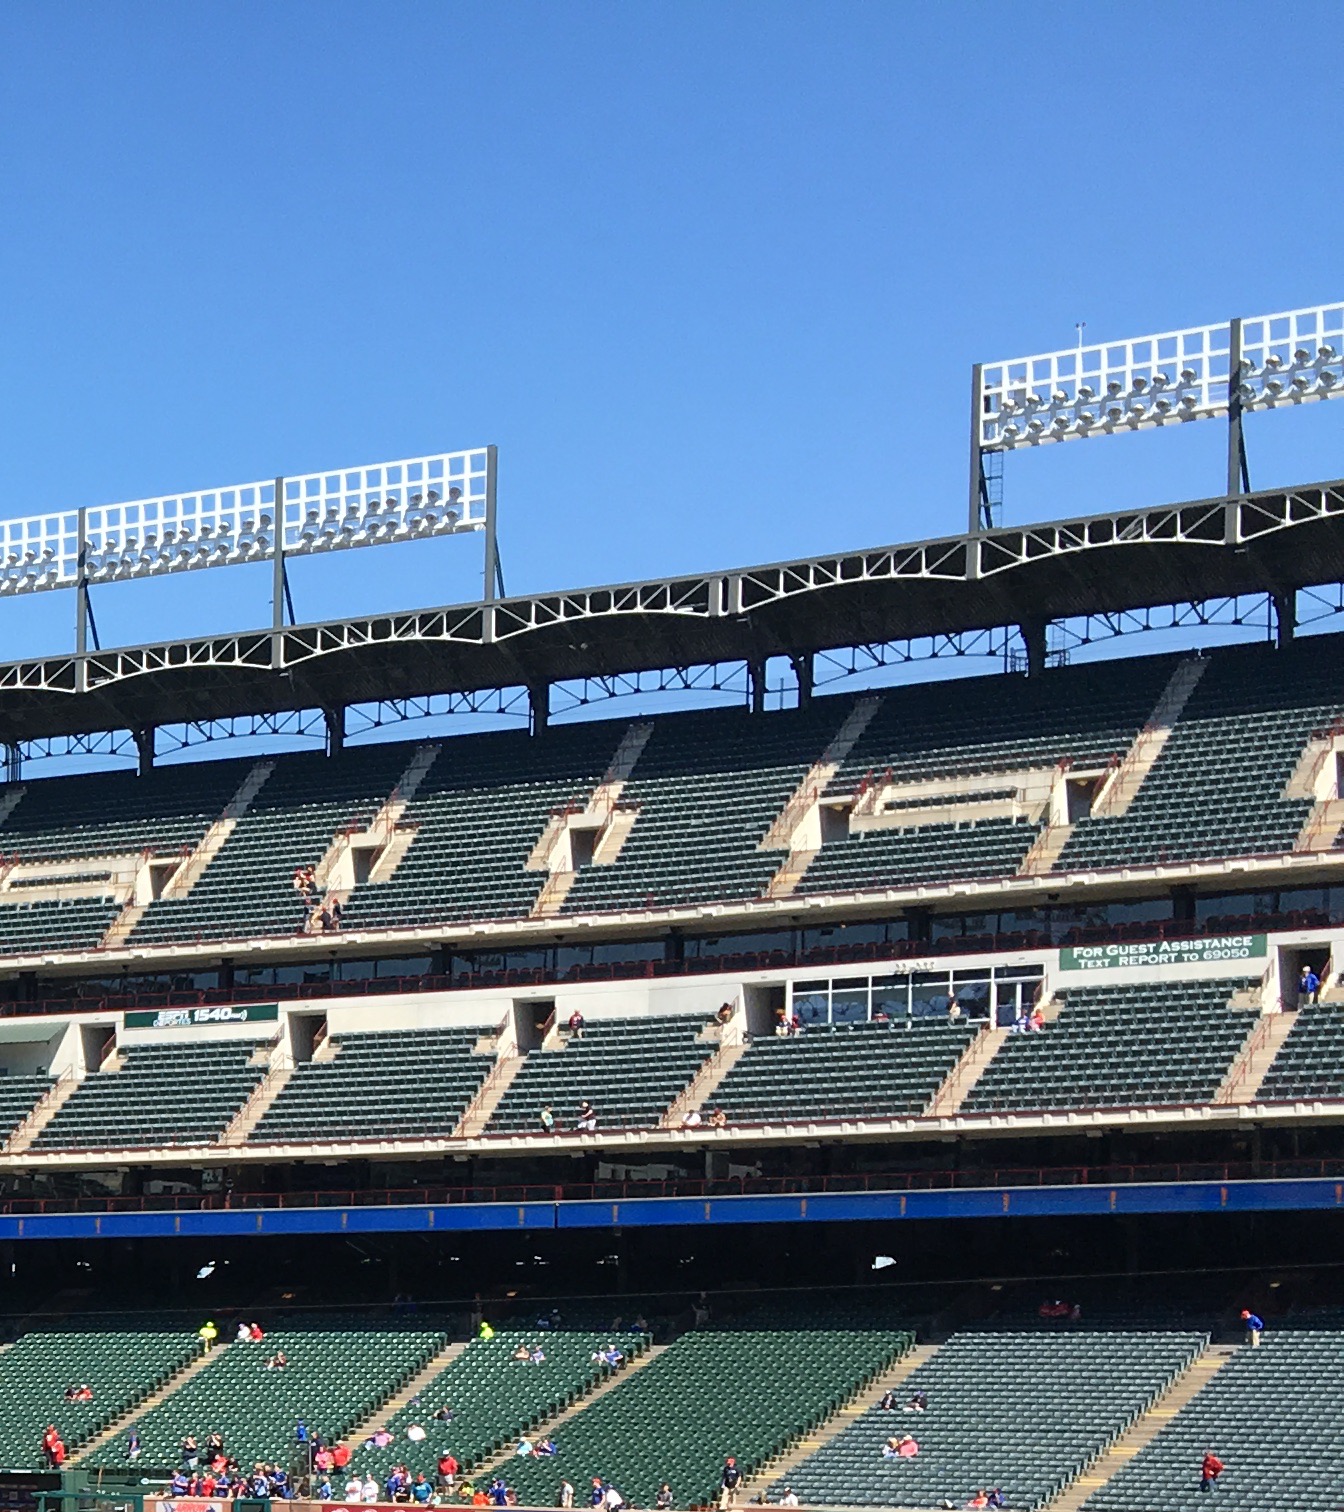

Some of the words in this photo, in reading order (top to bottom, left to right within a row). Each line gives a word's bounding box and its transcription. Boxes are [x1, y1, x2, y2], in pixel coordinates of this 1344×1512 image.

[1073, 946, 1103, 959] FOR
[1106, 943, 1156, 956] GUEST
[1159, 936, 1253, 953] ASSISTANCE
[1078, 958, 1111, 969] TEXT
[1118, 953, 1179, 967] REPORT
[1182, 952, 1199, 962] TO
[1203, 947, 1250, 960] 69050
[193, 1008, 233, 1022] 1540
[176, 1502, 209, 1512] ARROW
